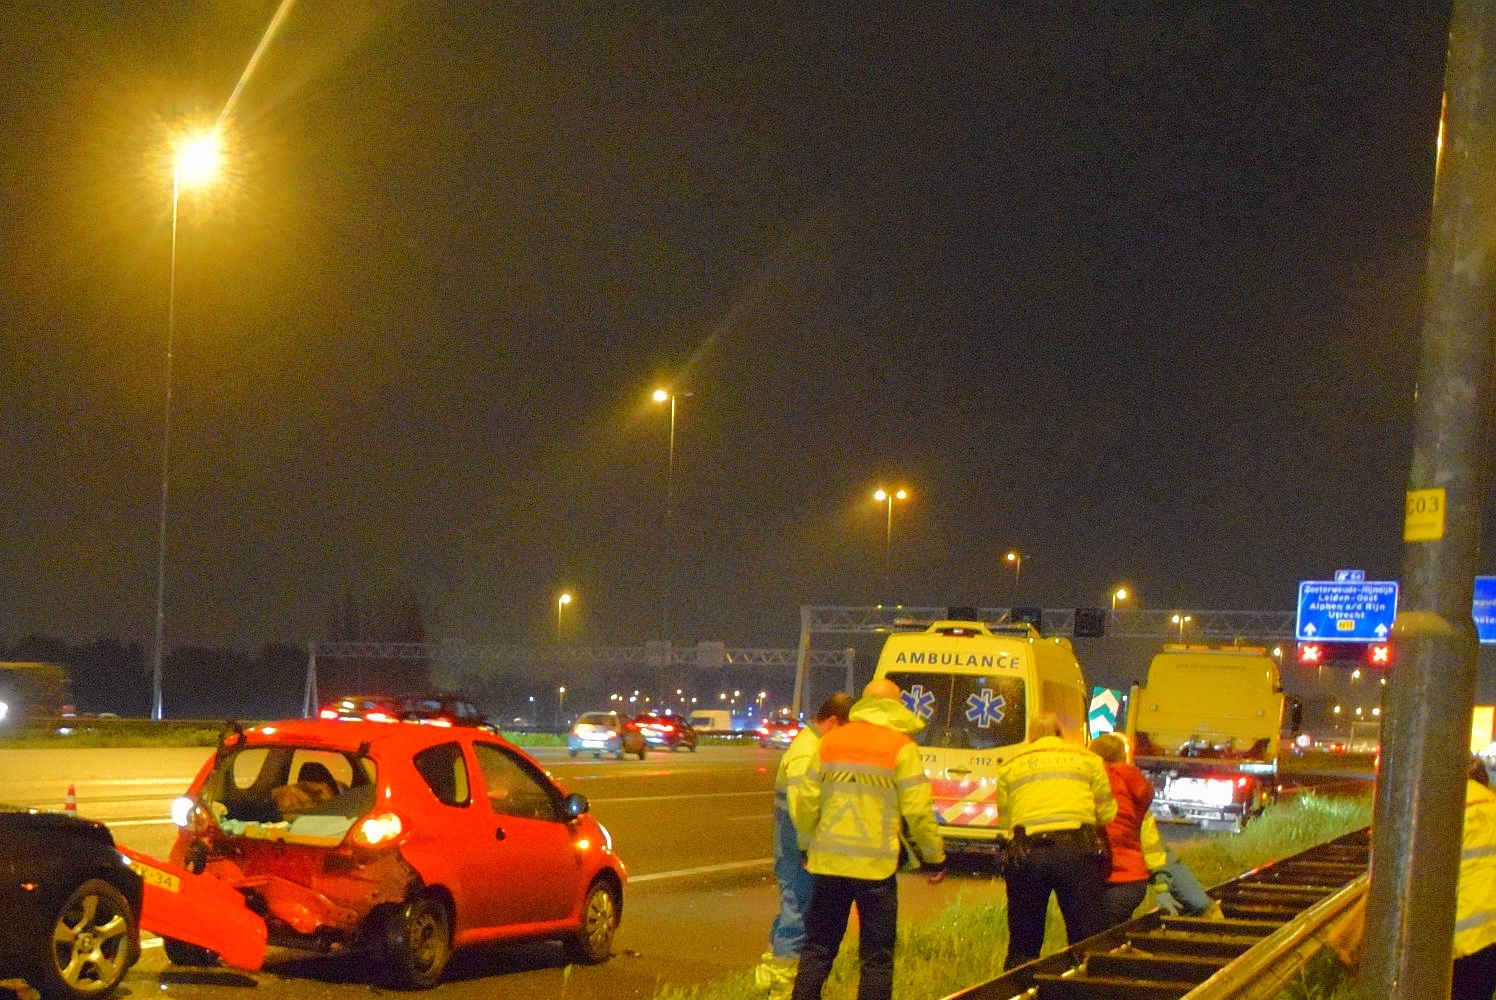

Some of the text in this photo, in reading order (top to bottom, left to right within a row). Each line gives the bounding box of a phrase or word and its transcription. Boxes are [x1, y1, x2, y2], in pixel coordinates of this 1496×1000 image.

[1309, 602, 1386, 612] Alphen a/d Rijn
[1328, 611, 1365, 619] Utrecht
[895, 651, 1020, 670] AMBULANCE
[976, 757, 992, 766] 112
